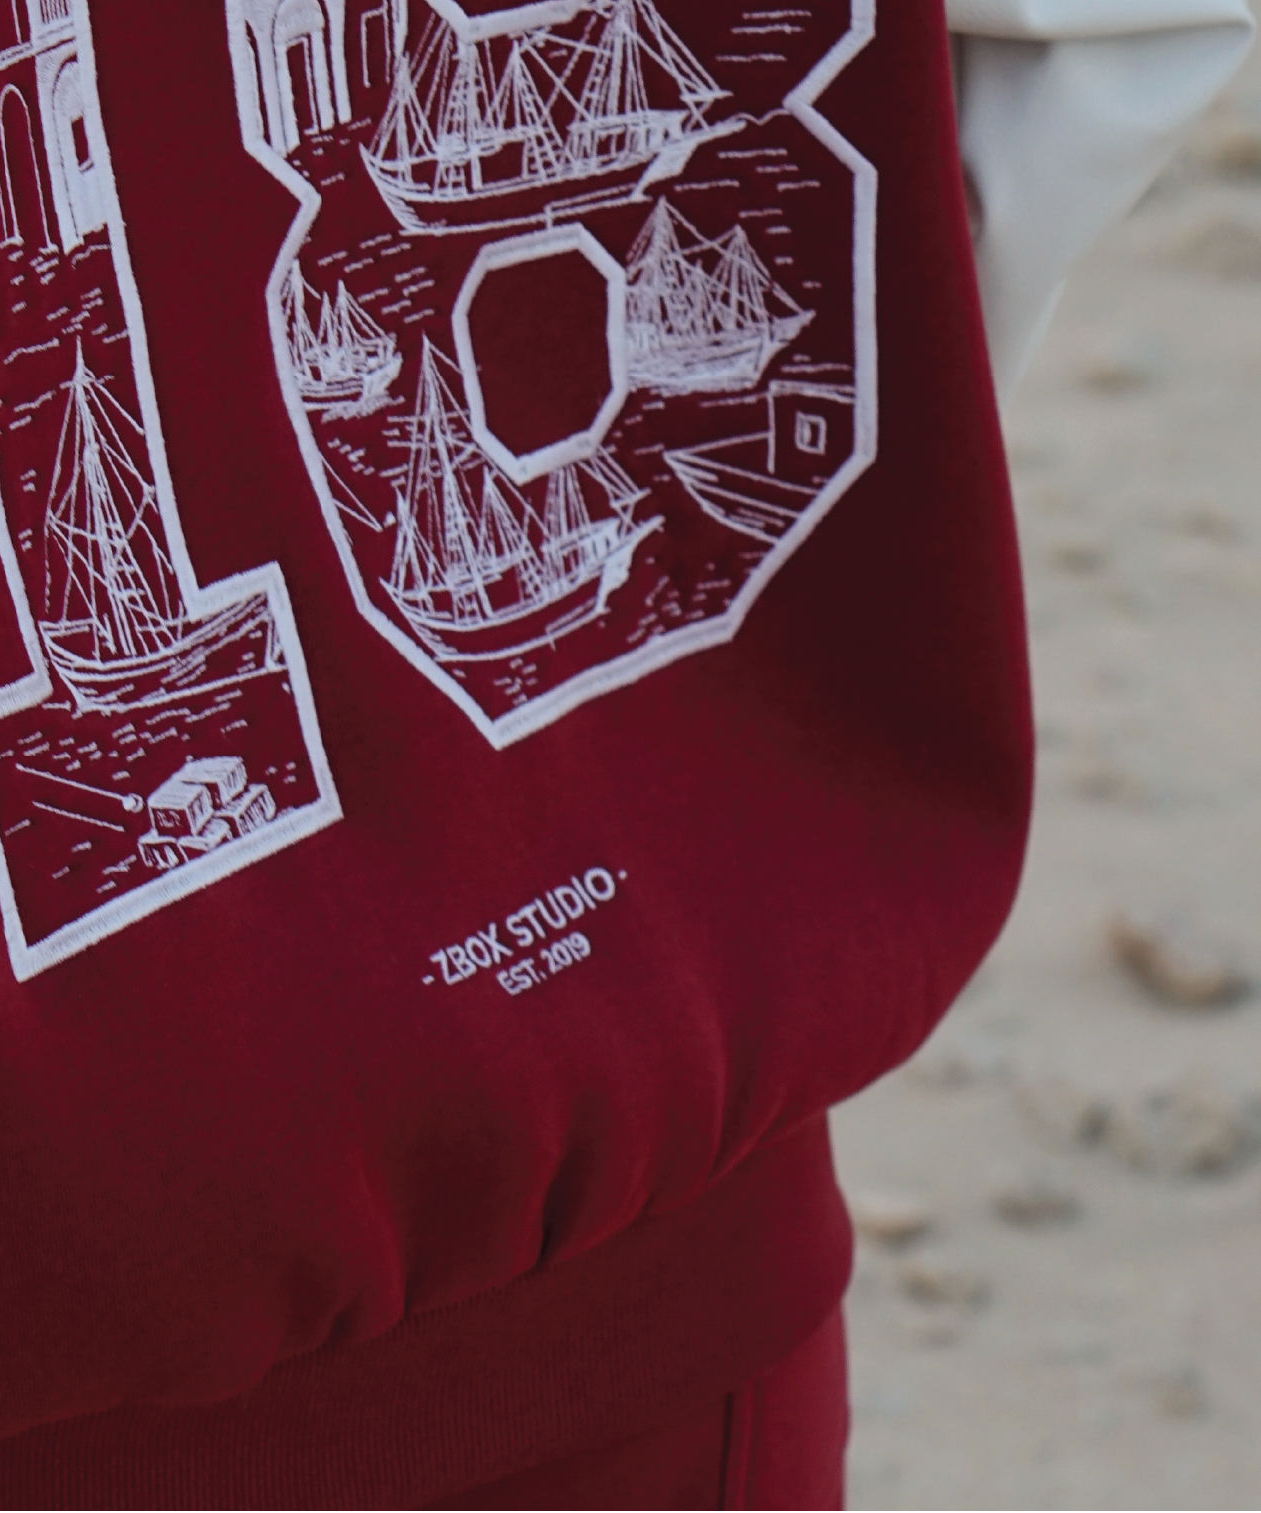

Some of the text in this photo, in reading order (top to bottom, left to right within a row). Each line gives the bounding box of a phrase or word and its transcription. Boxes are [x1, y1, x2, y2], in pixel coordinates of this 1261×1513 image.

[429, 867, 616, 985] ZBOX STUDIO
[496, 932, 591, 996] EST. 2019
